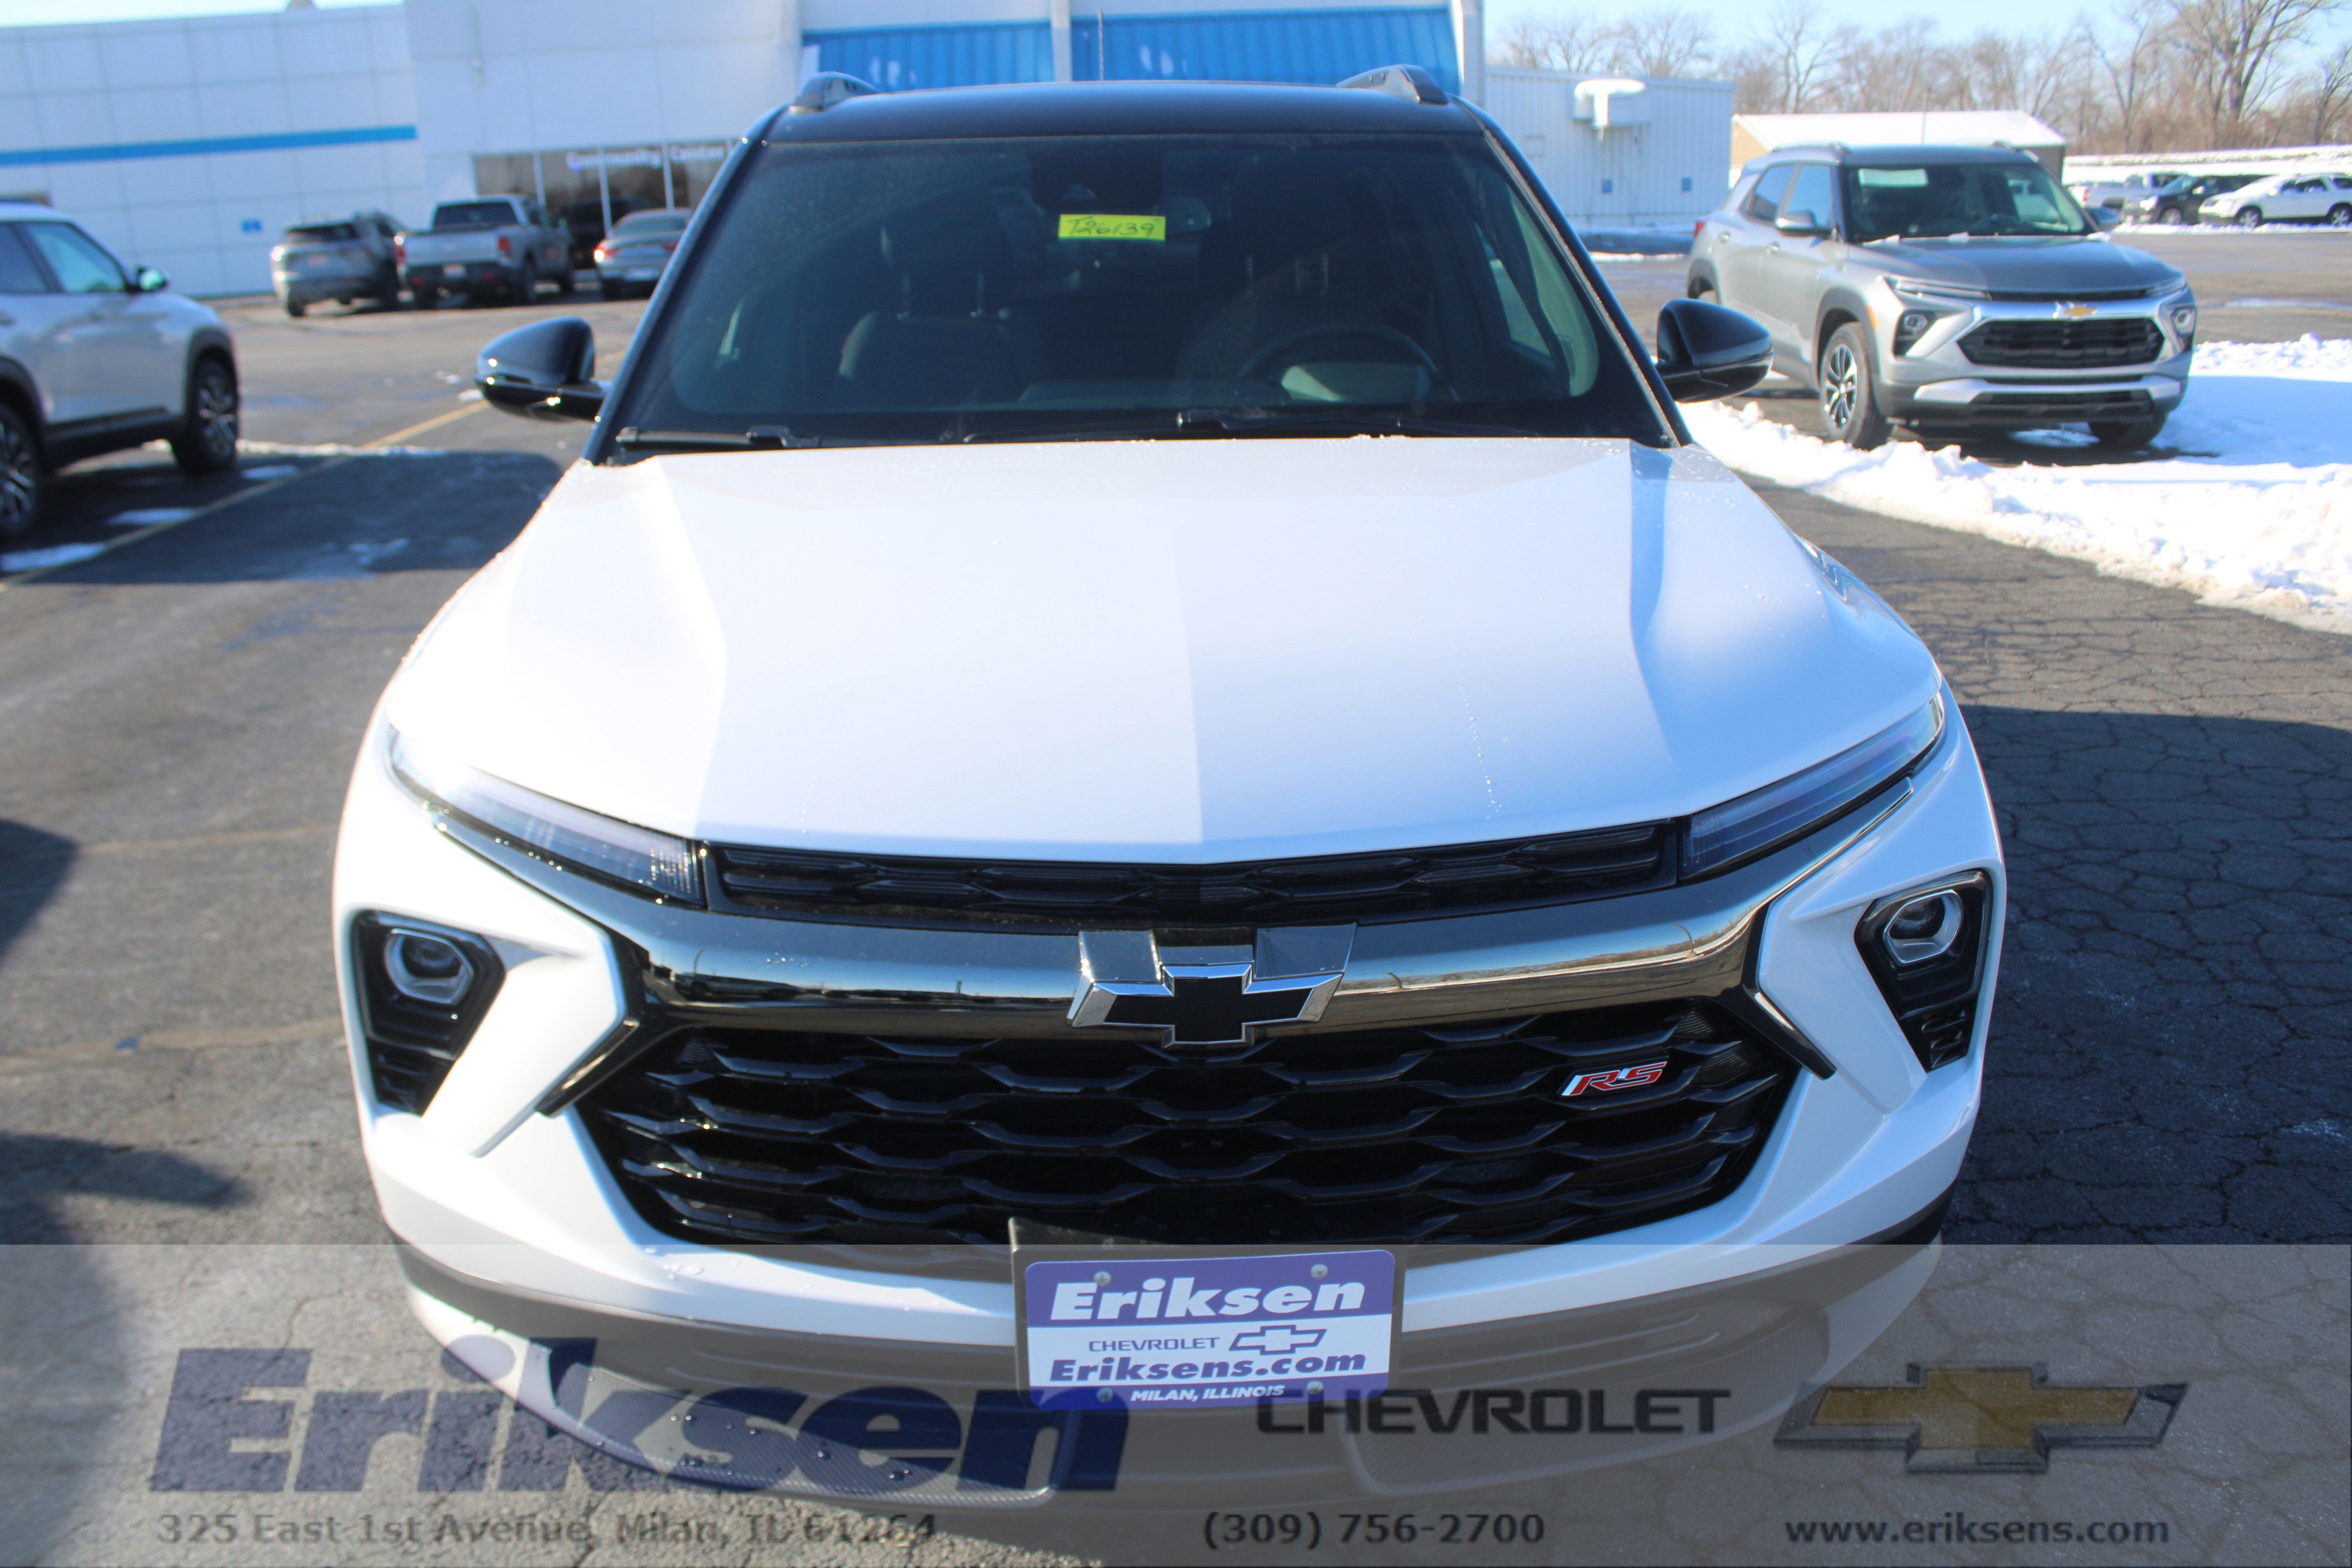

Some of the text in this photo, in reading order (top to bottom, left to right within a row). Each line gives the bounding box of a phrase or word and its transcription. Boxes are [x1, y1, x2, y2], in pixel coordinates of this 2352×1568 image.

[1067, 215, 1155, 237] T26139
[1561, 1061, 1667, 1096] RS
[1050, 1277, 1365, 1320] Eriksen
[1089, 1337, 1220, 1352] CHEVROLET
[1050, 1353, 1366, 1382] Eriksens.com
[1130, 1384, 1285, 1402] MILAN, ILLINOIS
